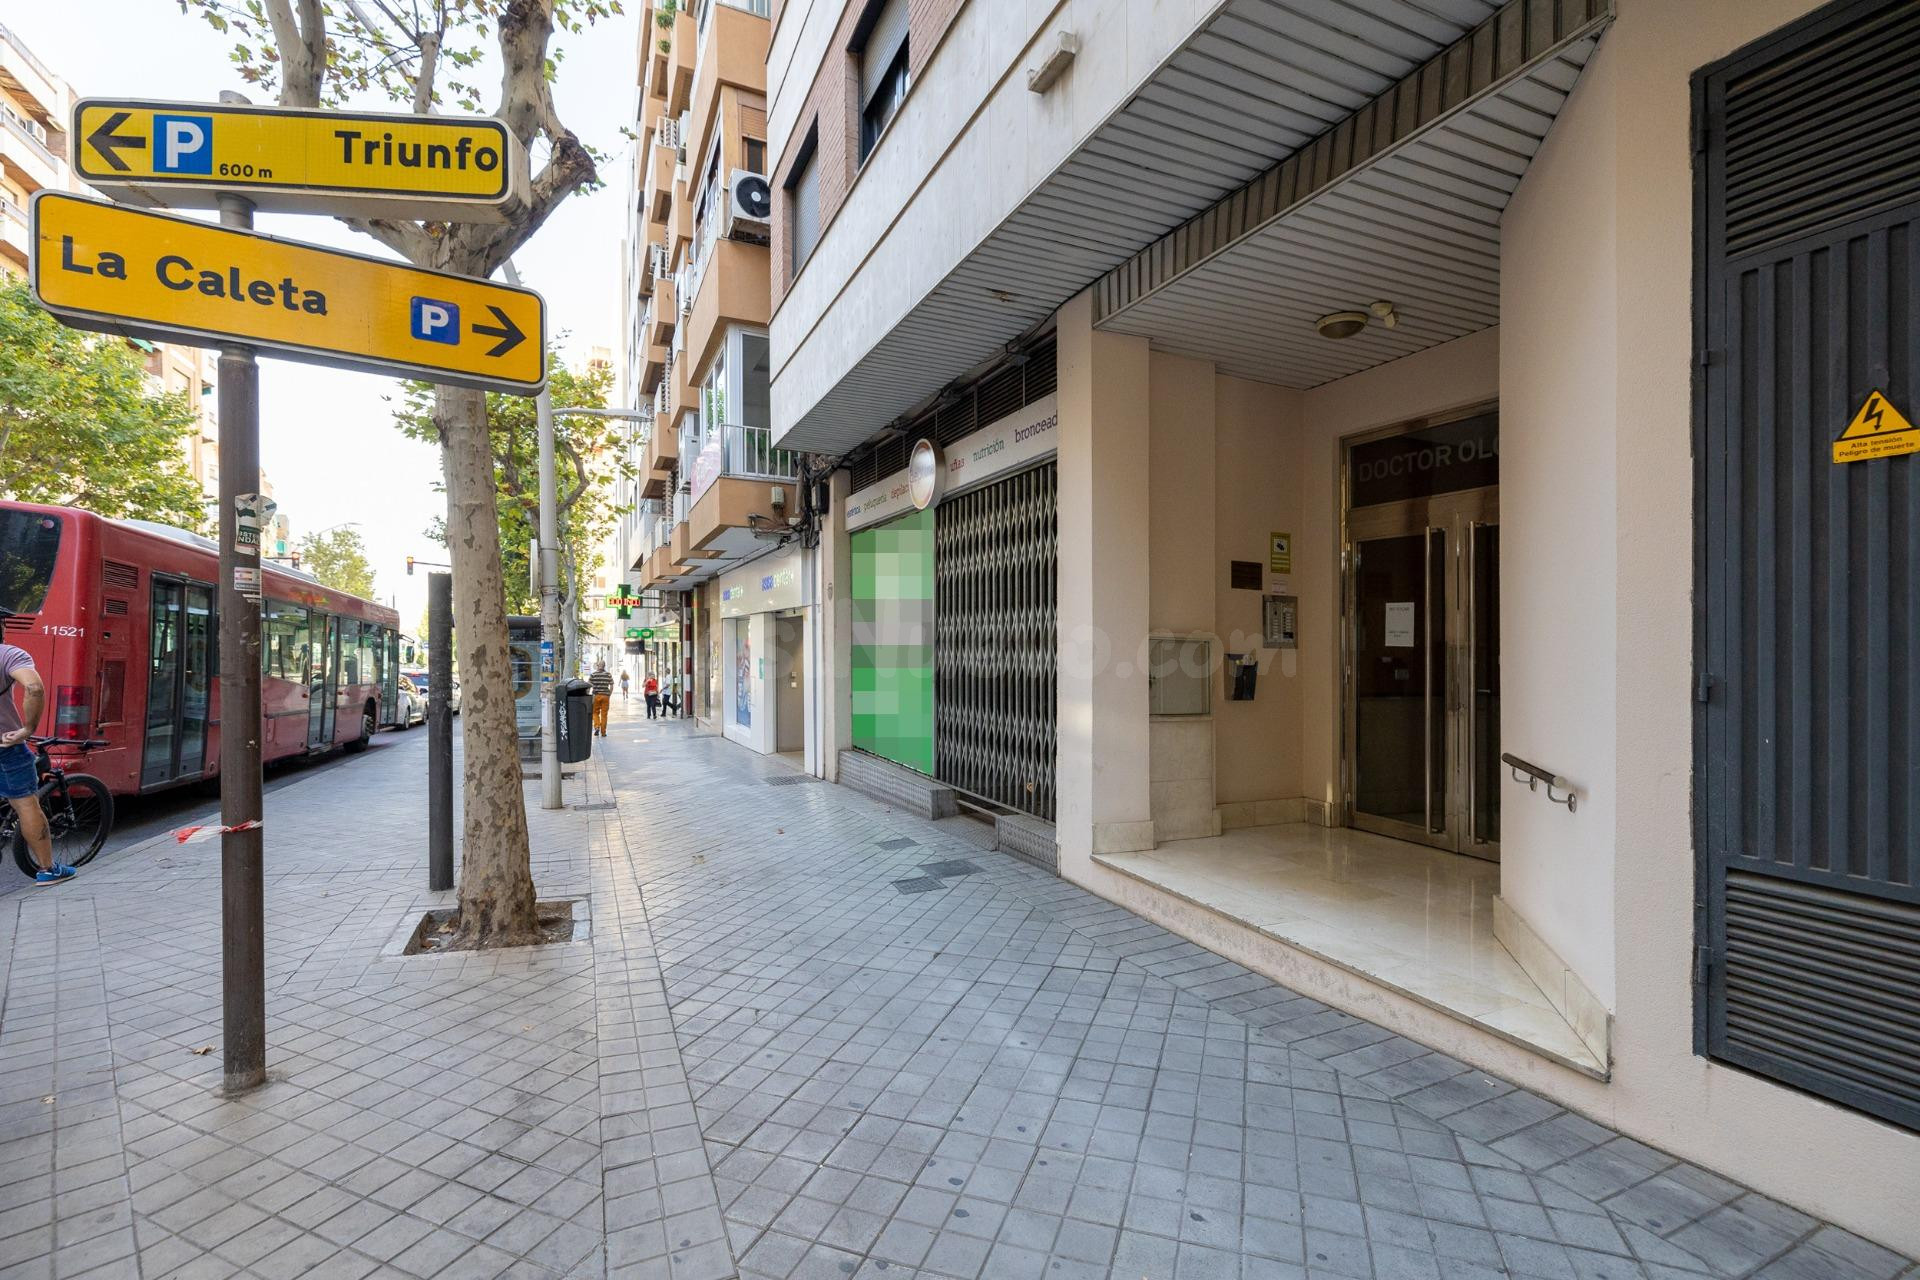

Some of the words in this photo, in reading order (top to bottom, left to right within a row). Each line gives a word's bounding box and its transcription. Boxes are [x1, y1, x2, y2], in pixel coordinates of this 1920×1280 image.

[166, 121, 206, 169] P
[219, 163, 254, 178] 600
[258, 167, 273, 179] m
[334, 130, 499, 172] Triunfo
[61, 235, 128, 281] La
[155, 255, 328, 317] Caleta
[421, 303, 450, 335] P
[1014, 408, 1057, 443] broncead
[1359, 445, 1451, 482] DOCTOR
[1839, 449, 1869, 457] Peligro
[1883, 442, 1915, 450] muerte
[42, 625, 84, 637] 11521
